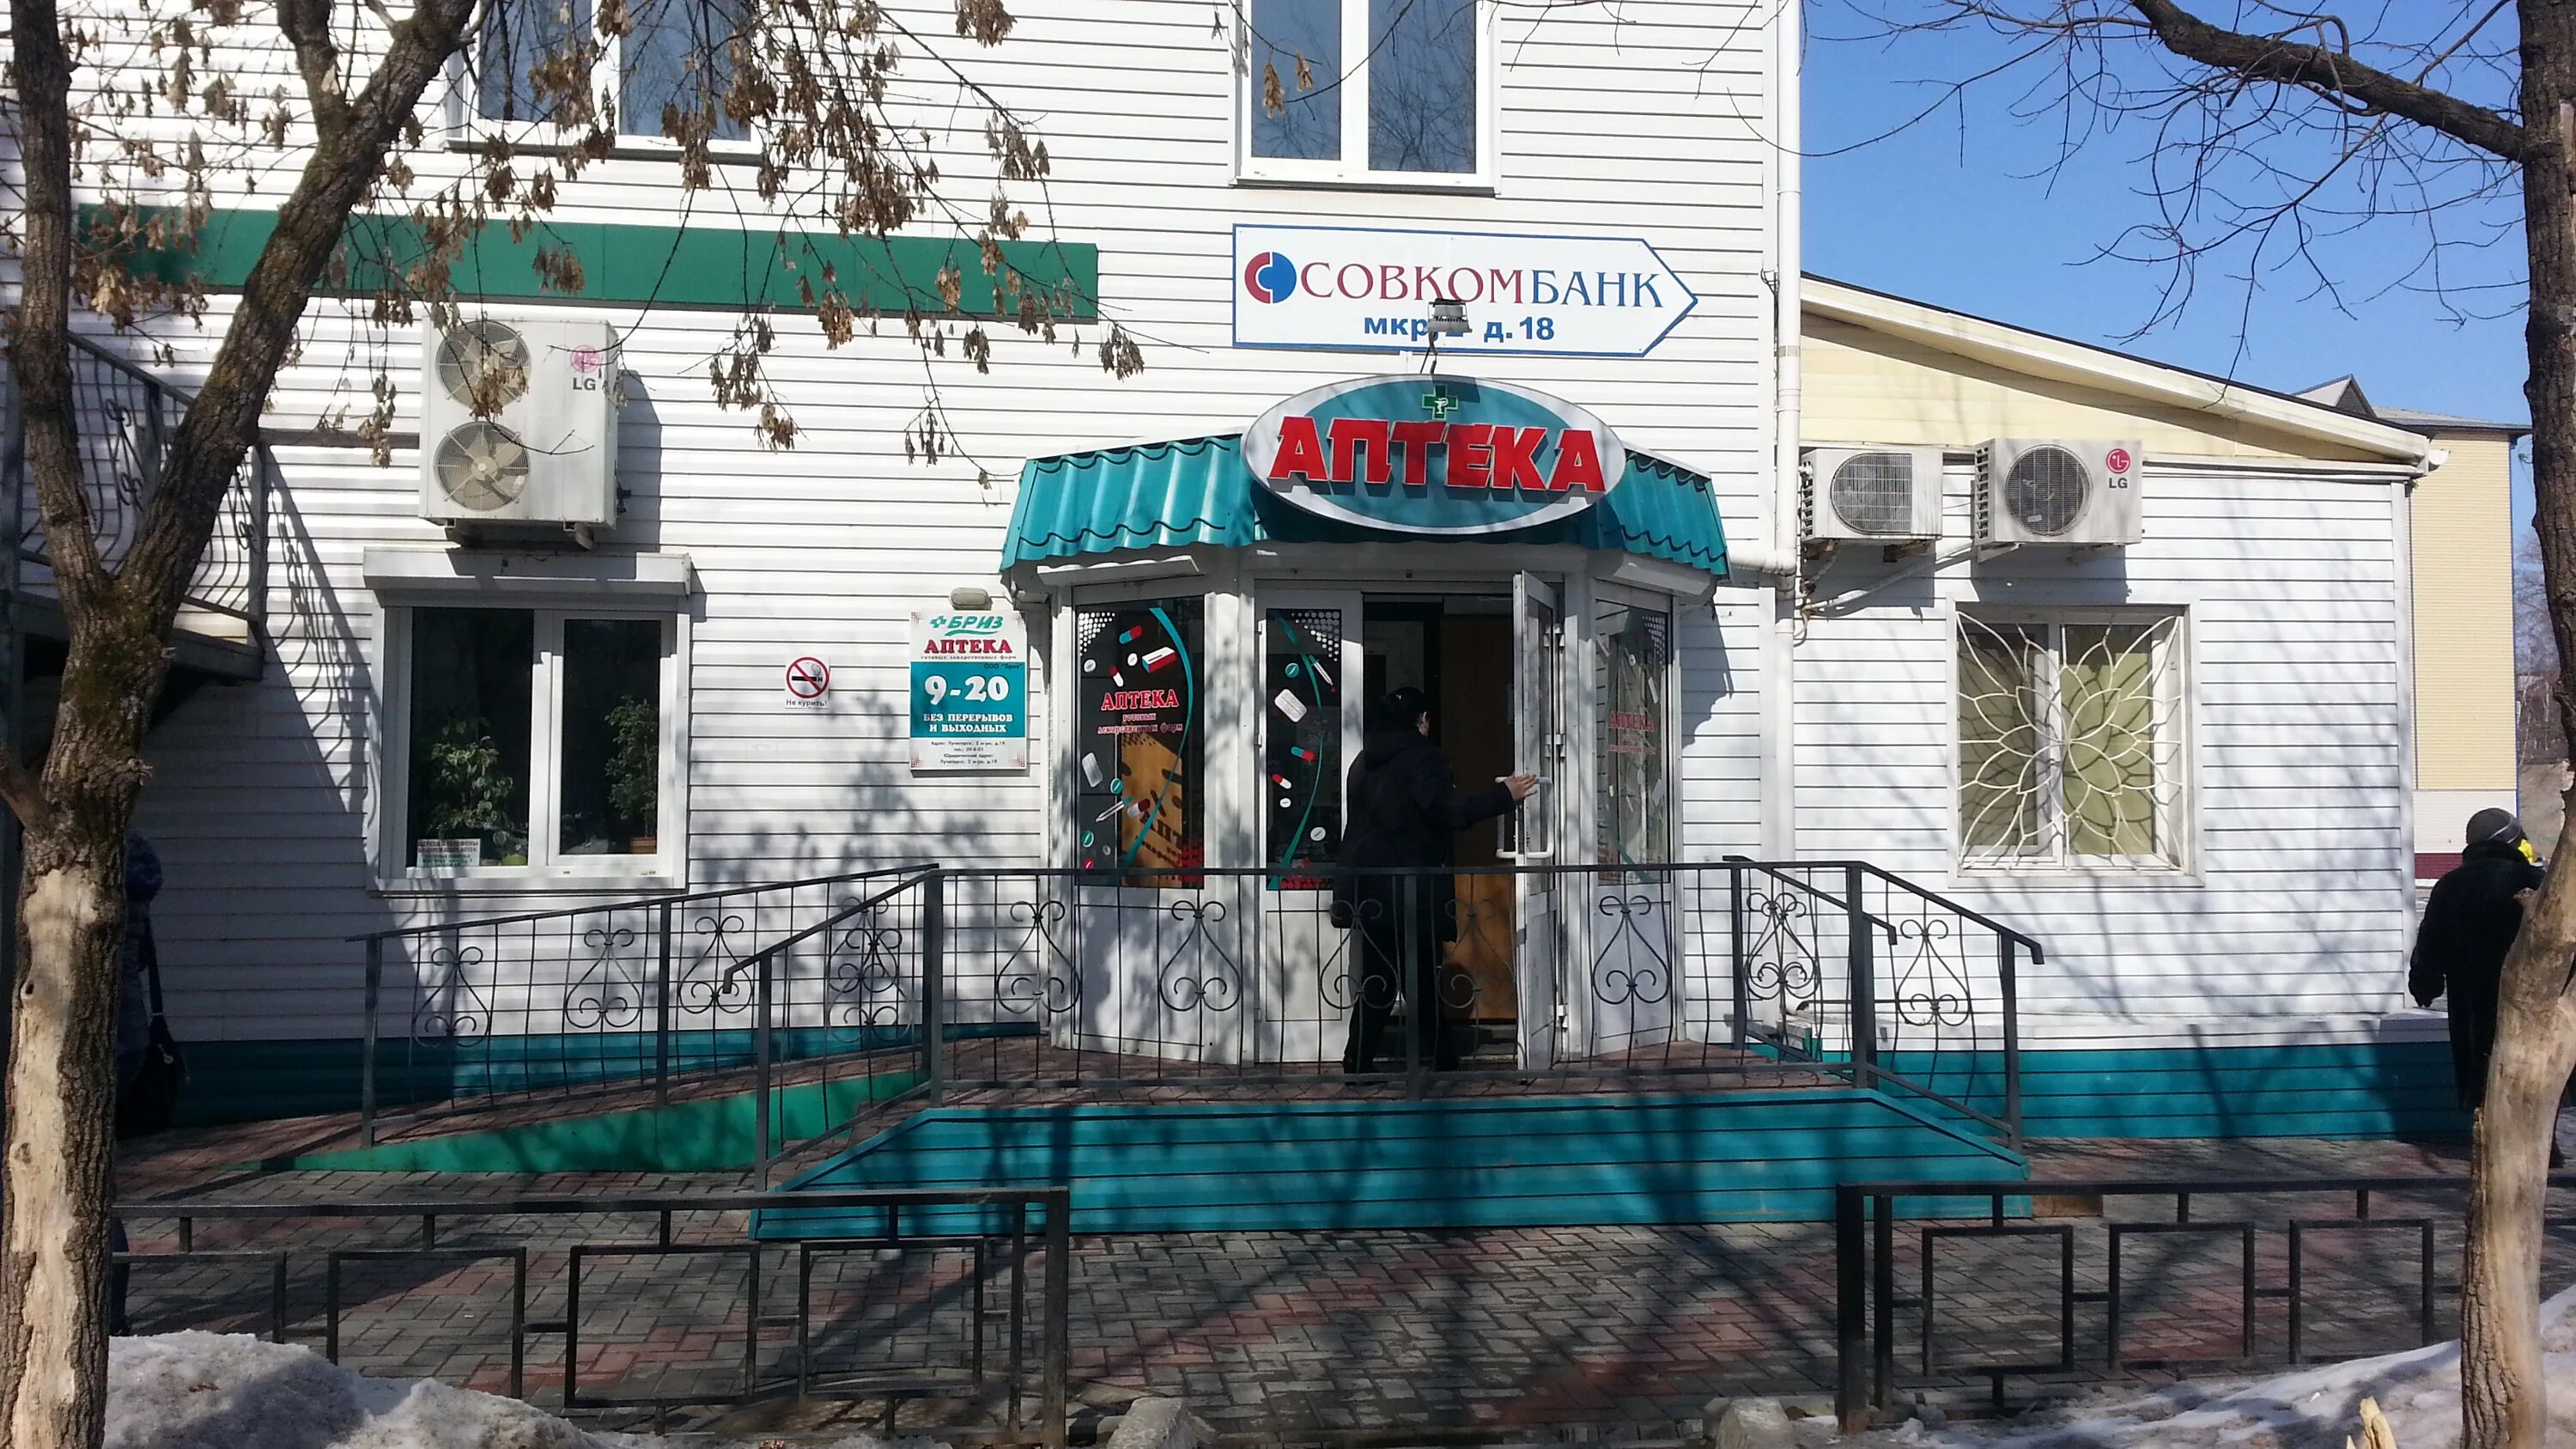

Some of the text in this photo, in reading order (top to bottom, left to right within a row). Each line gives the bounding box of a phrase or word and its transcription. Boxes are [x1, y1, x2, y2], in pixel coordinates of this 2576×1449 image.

[1300, 262, 1664, 307] СОВКОМБАНК
[572, 377, 597, 391] LG
[1267, 416, 1607, 492] АПТЕКА
[2108, 477, 2128, 489] LG
[947, 615, 1004, 629] БРИЗ
[924, 639, 1012, 654] АПТЕКА
[1101, 689, 1179, 710] АПТЕКА
[948, 714, 1013, 722] ПЕРЕРЫВОВ
[941, 724, 1007, 734] ВЫХОДНЫХ
